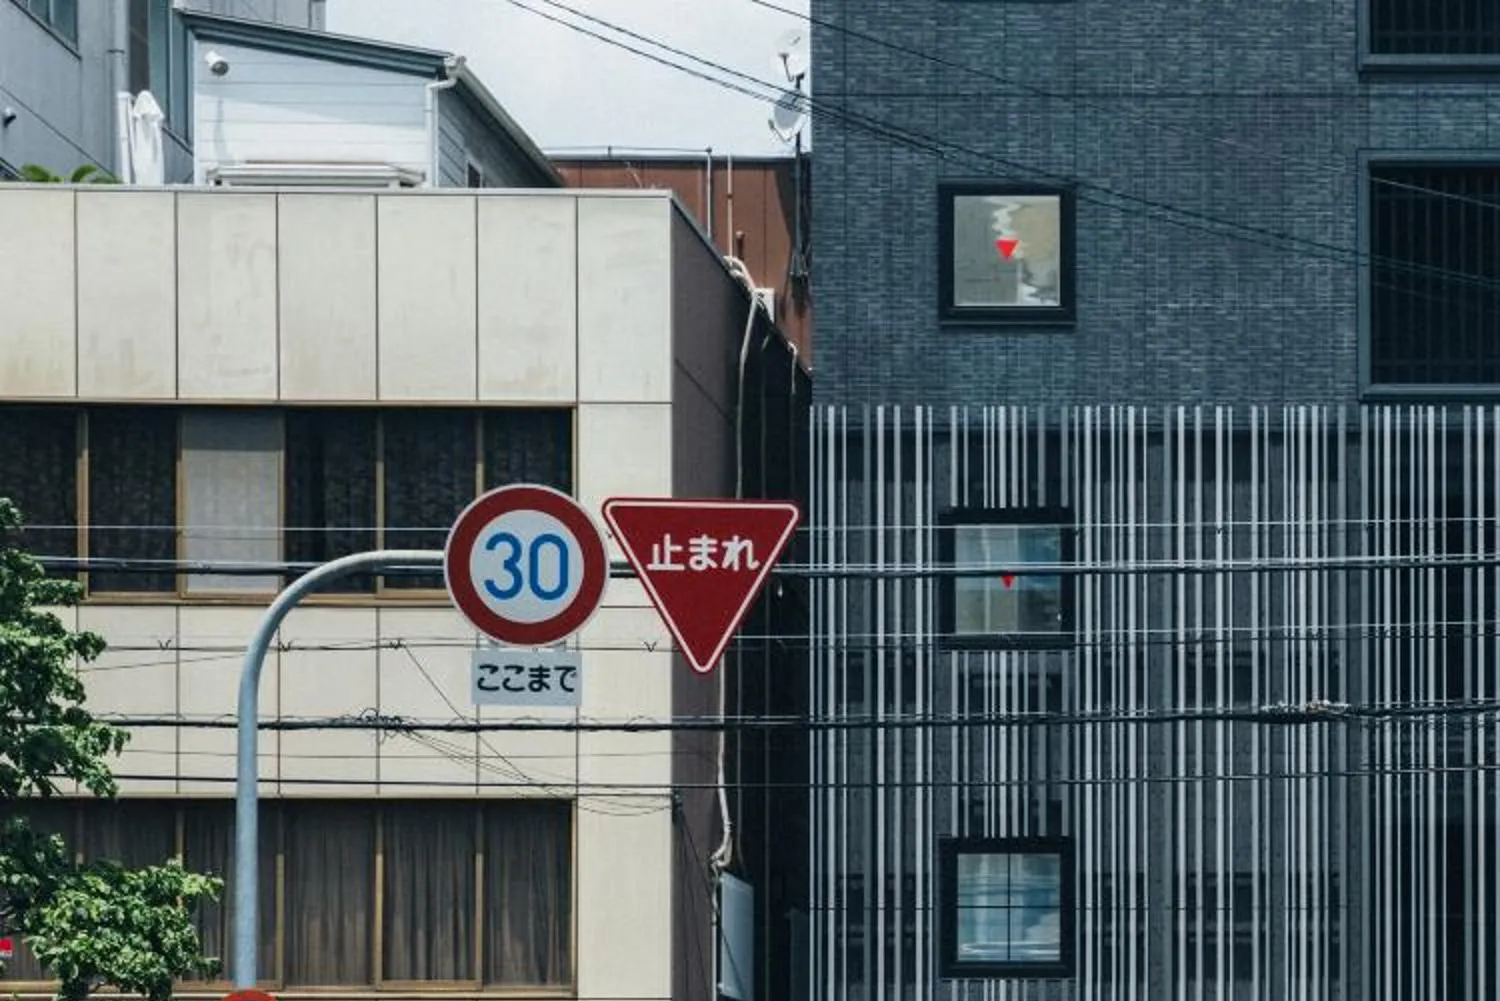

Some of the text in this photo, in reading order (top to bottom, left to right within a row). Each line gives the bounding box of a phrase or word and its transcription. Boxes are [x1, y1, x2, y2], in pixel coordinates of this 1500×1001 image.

[484, 531, 569, 601] 30
[647, 533, 759, 572] 止まれ
[477, 663, 577, 693] ここまで
